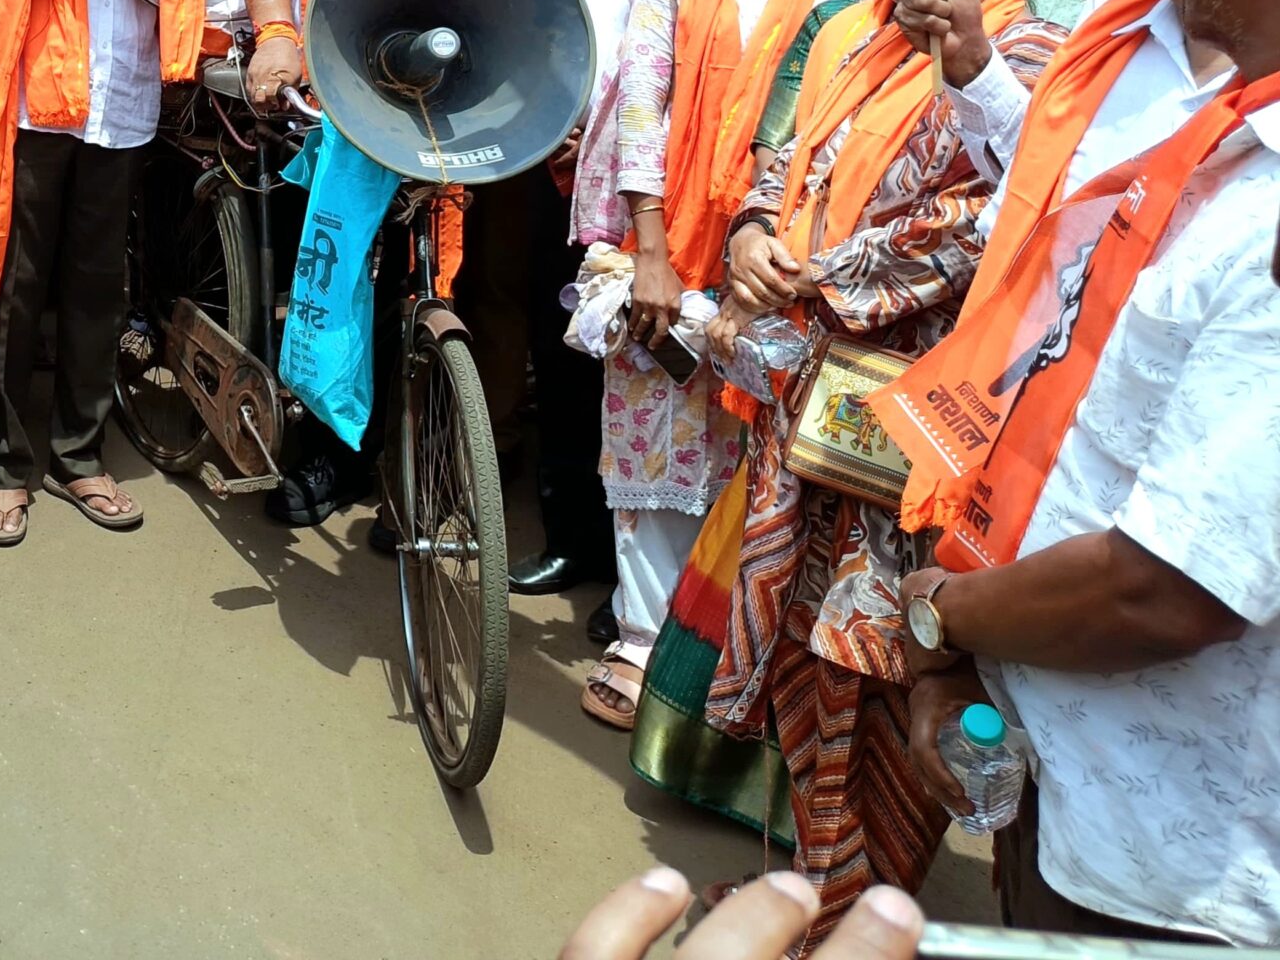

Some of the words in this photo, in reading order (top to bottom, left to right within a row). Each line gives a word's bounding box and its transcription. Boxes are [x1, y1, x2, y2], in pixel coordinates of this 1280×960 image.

[418, 147, 504, 165] AHUJA
[927, 383, 990, 451] मशाल
[955, 381, 1001, 427] निशाणी
